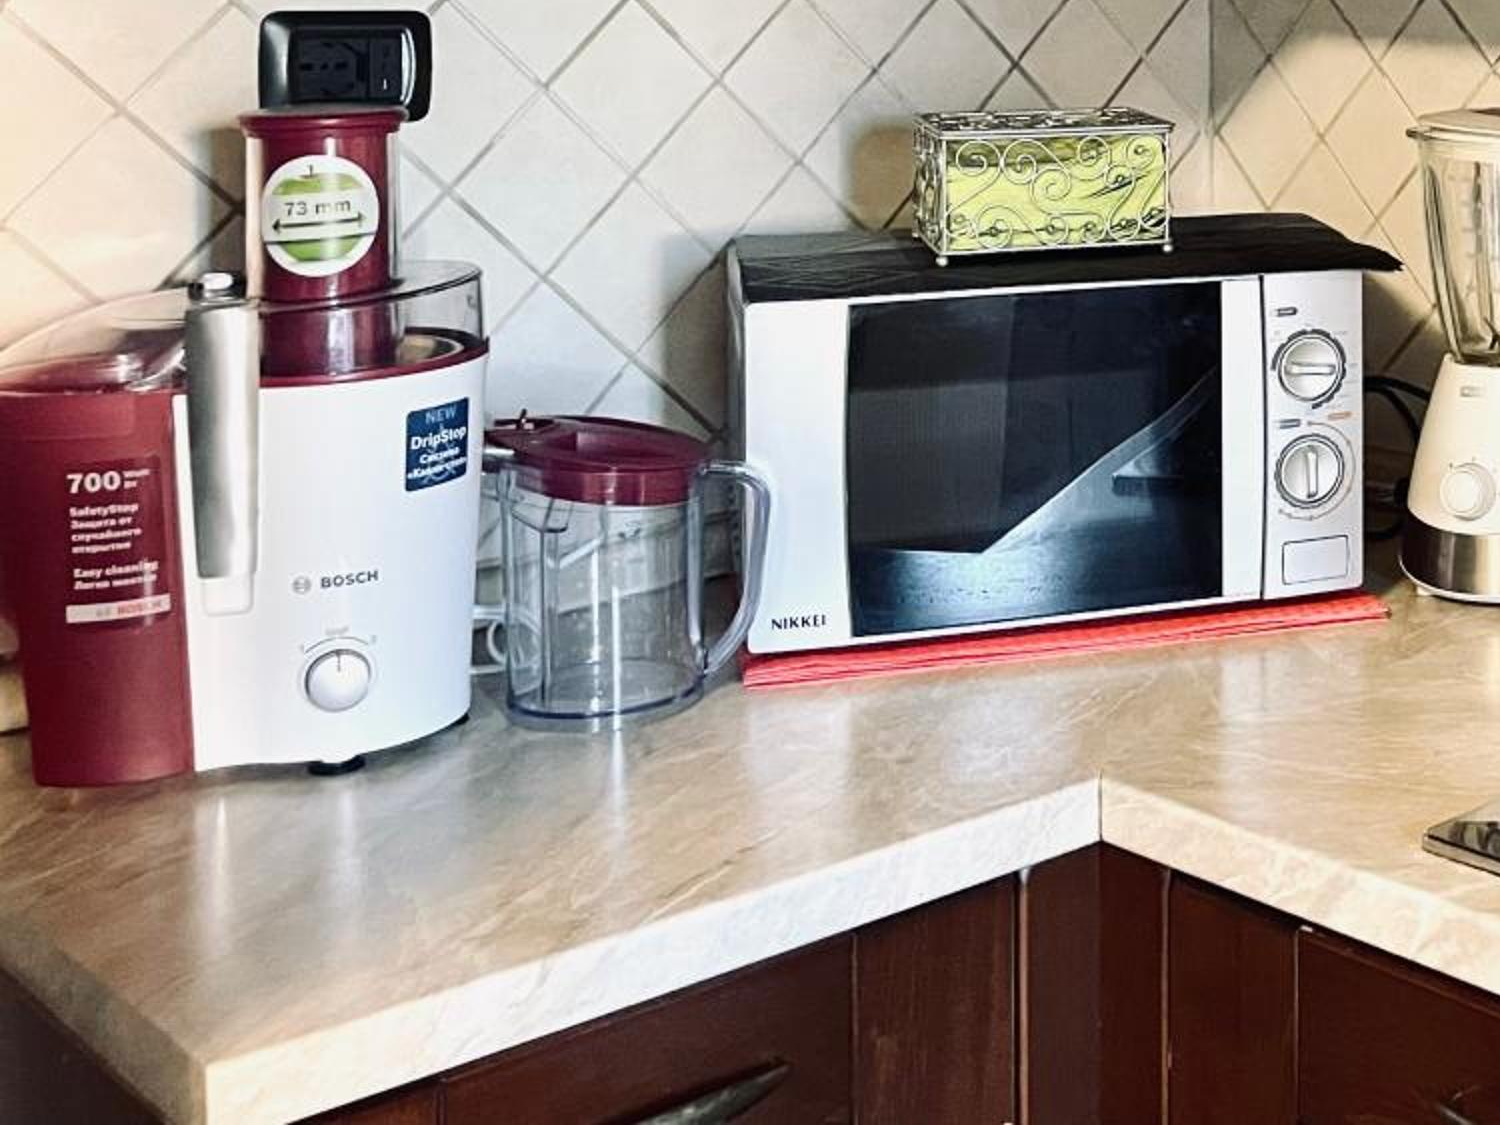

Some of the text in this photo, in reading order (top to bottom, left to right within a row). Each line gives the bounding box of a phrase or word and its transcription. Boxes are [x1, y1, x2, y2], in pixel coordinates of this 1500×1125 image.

[285, 200, 351, 216] 73 mm
[425, 404, 457, 424] NEW
[411, 427, 467, 450] DripStop
[66, 470, 121, 494] 700
[73, 567, 103, 579] Easy
[321, 570, 379, 588] BOSCH
[771, 614, 826, 630] NIKKEI
